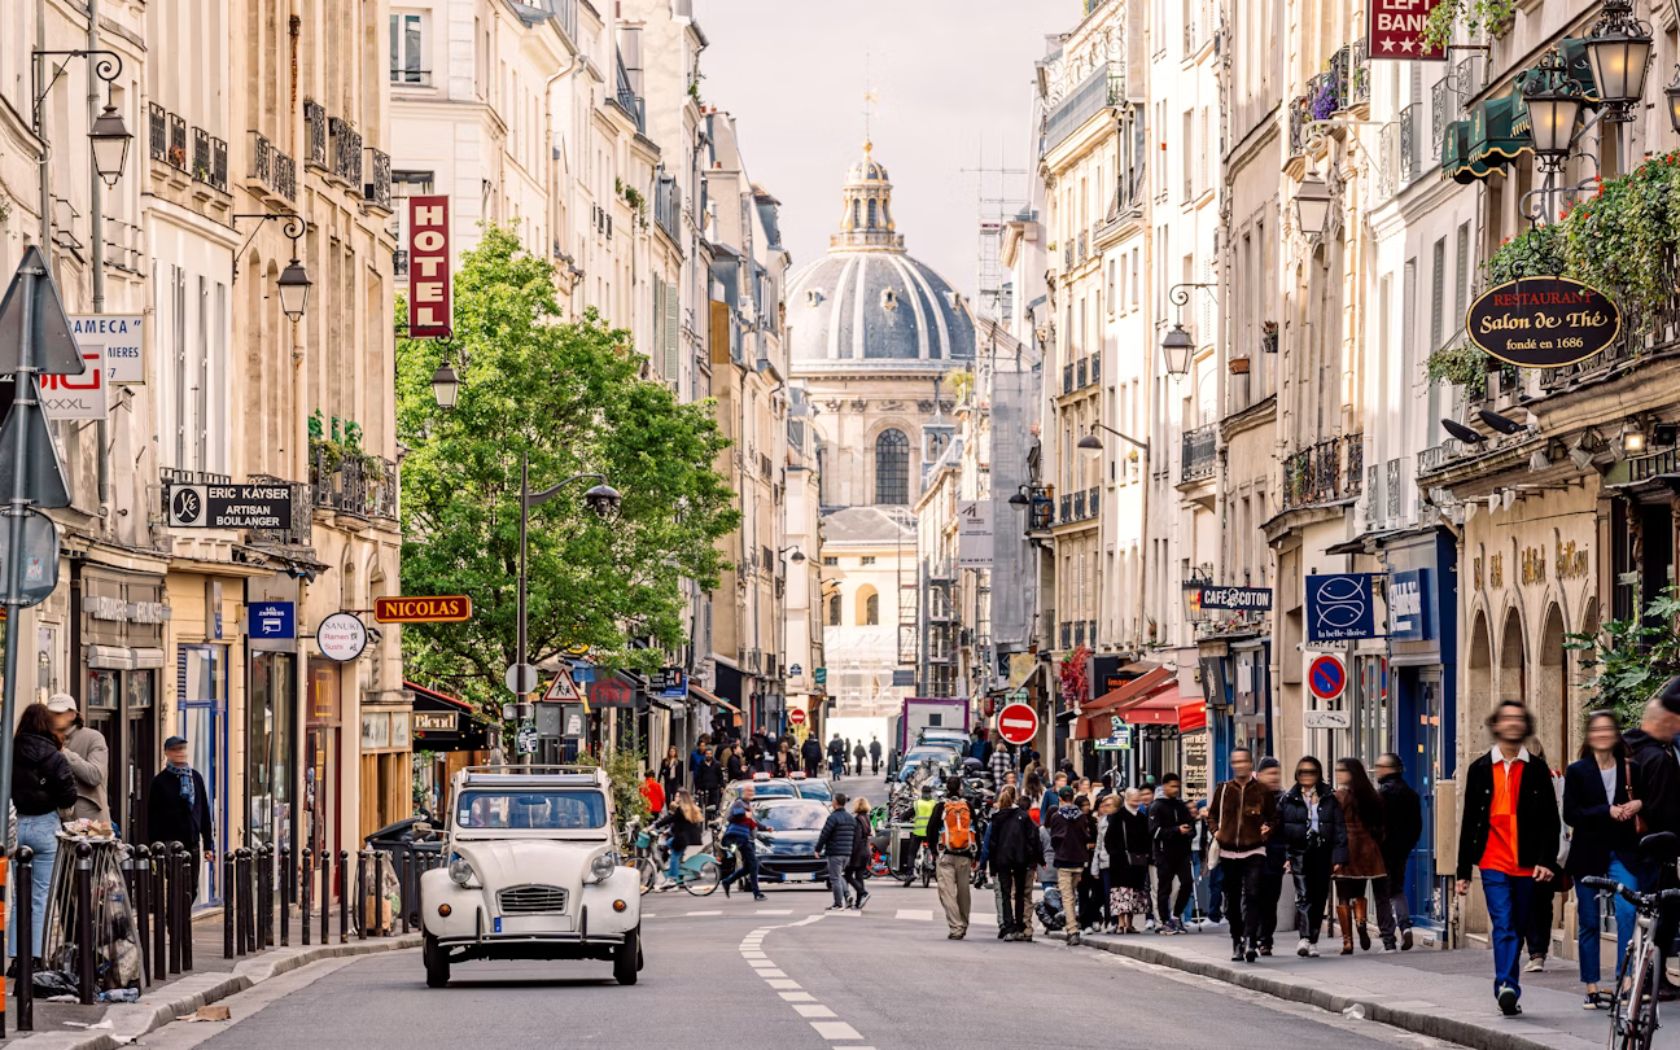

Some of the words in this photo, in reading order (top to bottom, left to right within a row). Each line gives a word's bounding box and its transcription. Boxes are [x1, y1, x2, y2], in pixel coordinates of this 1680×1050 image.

[1378, 14, 1436, 31] BANK
[414, 205, 445, 326] HOTEL
[1494, 291, 1596, 306] RESTAURANT
[1480, 313, 1531, 334] Salon
[1535, 312, 1562, 329] de
[1566, 311, 1608, 328] Thé
[1506, 339, 1536, 350] fondé
[1540, 341, 1552, 349] en
[1557, 337, 1583, 348] 1686
[209, 488, 236, 498] ERIC
[242, 488, 289, 499] KAYSER
[226, 505, 270, 515] ARTISAN
[216, 516, 279, 526] BOULANGER
[1204, 590, 1227, 605] CAFÉ
[1240, 592, 1269, 606] COTON
[385, 600, 459, 616] NICOLAS
[415, 714, 454, 728] Blend
